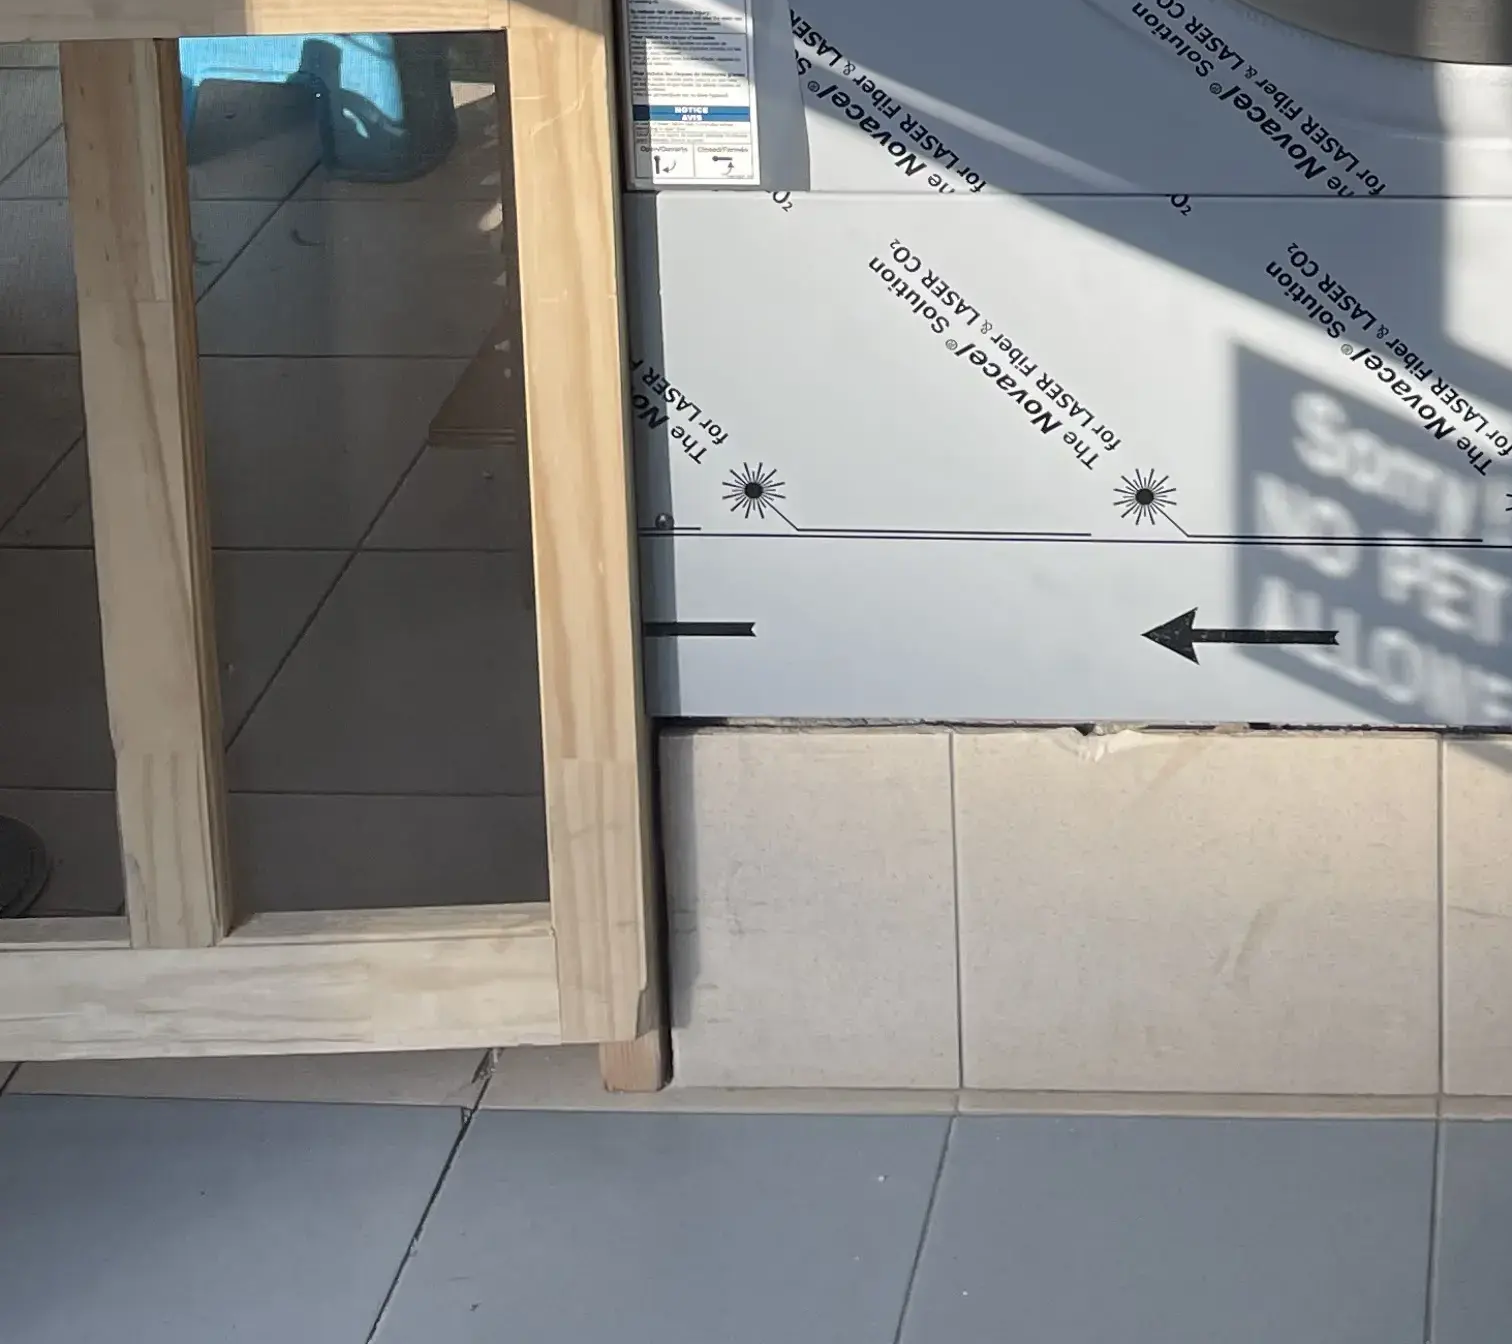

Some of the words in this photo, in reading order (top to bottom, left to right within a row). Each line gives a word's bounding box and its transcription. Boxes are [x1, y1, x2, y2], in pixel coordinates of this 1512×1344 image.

[1131, 1, 1215, 77] Solution
[1184, 15, 1245, 71] LASER
[1244, 64, 1259, 80] &
[1254, 78, 1304, 121] Fiber
[1300, 114, 1360, 173] LASER
[1355, 164, 1387, 197] for
[868, 256, 950, 334] Solution
[920, 269, 981, 326] LASER
[1265, 261, 1346, 339] Solution
[1317, 273, 1378, 331] LASER
[980, 319, 993, 335] &
[1376, 323, 1390, 340] &
[990, 333, 1038, 378] Fiber
[1385, 338, 1434, 382] Fiber
[1035, 372, 1095, 428] LASER
[1430, 377, 1489, 433] LASER
[1063, 431, 1099, 471] The
[1090, 424, 1121, 452] for
[1456, 436, 1492, 477] The
